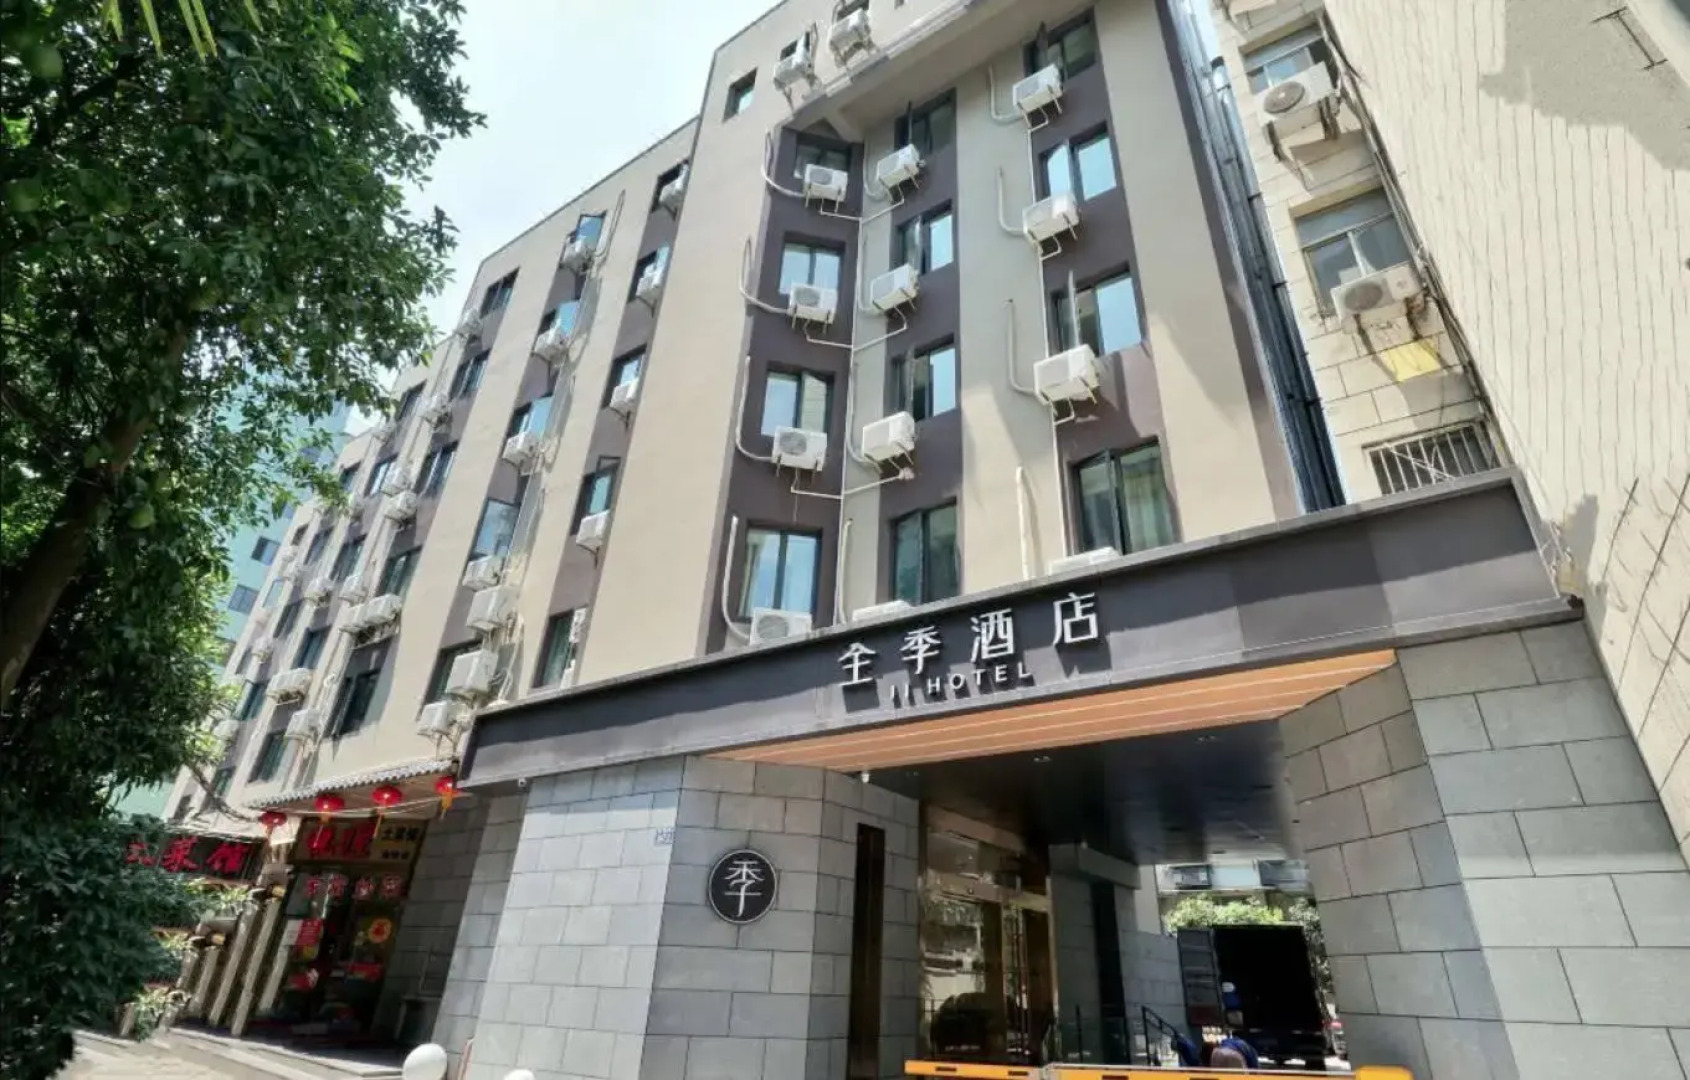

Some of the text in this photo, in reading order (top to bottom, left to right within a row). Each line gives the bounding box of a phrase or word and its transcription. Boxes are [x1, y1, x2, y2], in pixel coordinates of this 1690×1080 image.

[838, 592, 1099, 686] 全季酒店
[927, 662, 1032, 695] HOTEL
[724, 860, 765, 917] 季
